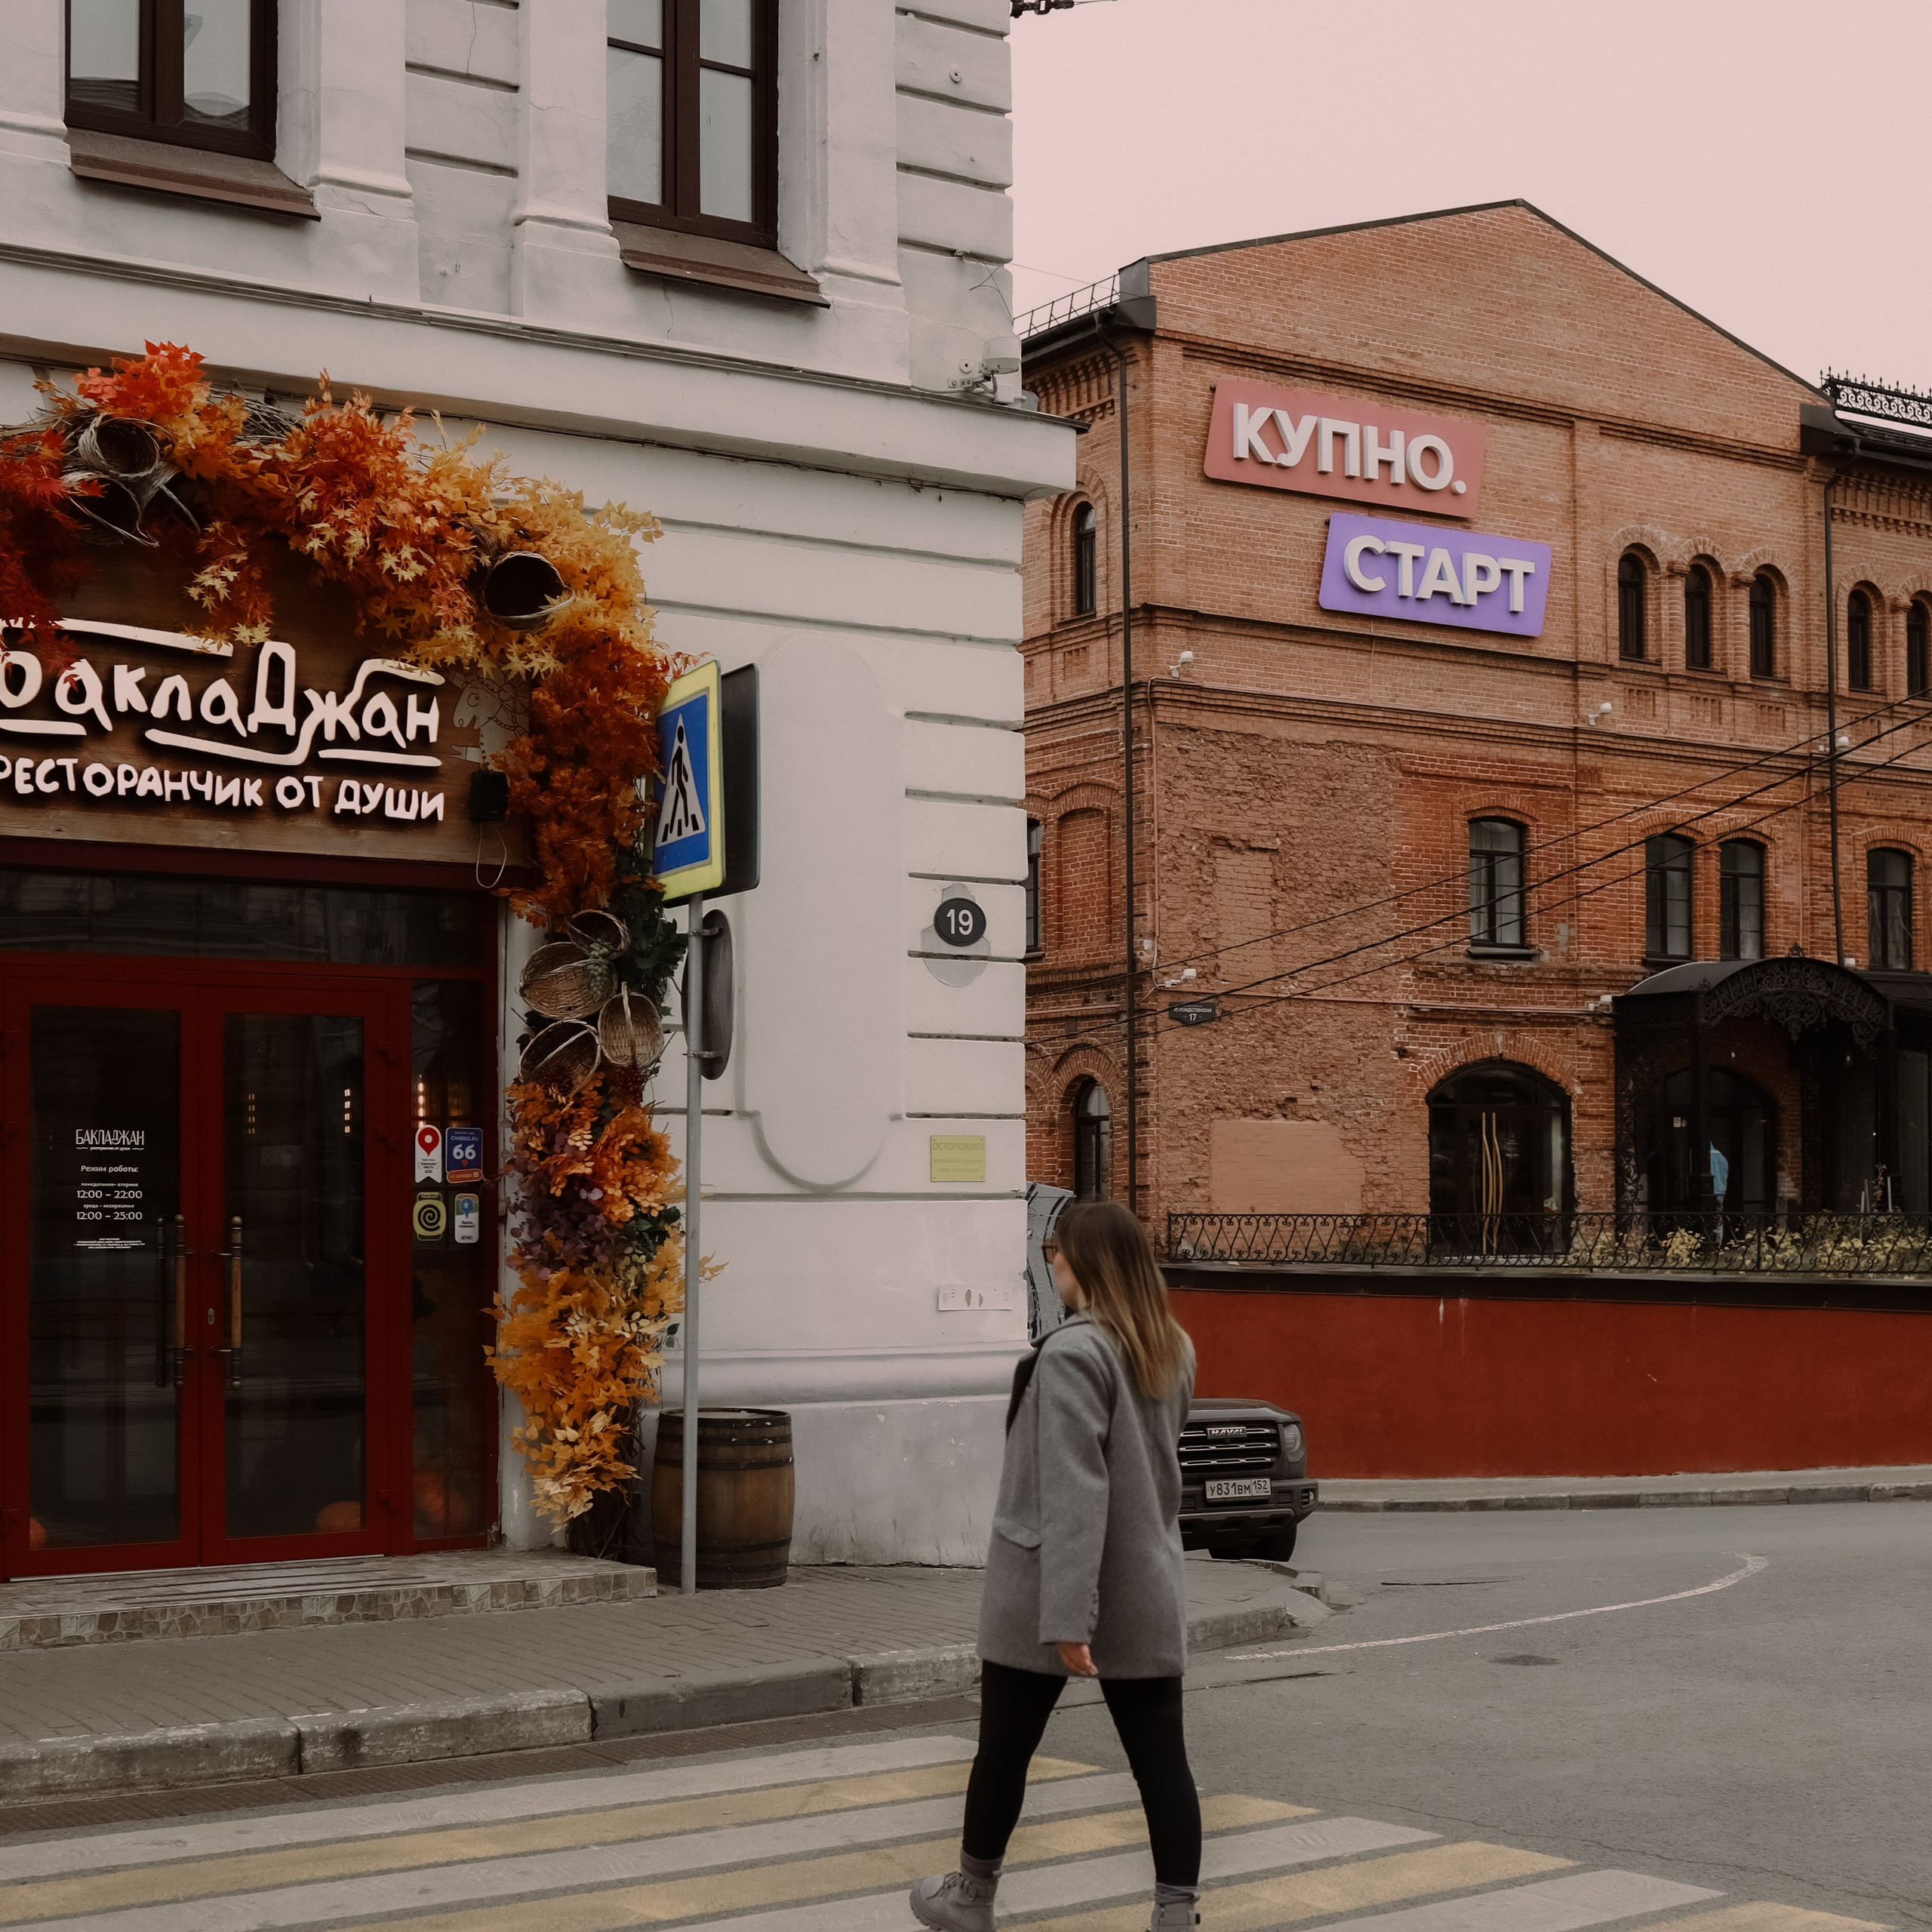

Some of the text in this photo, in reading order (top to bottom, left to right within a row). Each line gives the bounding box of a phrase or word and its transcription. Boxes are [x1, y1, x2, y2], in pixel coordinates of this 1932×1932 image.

[1232, 402, 1467, 495] КУПНО.
[1343, 534, 1536, 613] СТАРТ
[275, 776, 325, 809] ОТ
[334, 780, 445, 822] ДУШИ
[946, 909, 974, 936] 19
[1189, 1013, 1197, 1021] 17
[75, 1129, 145, 1146] БАКЛАДЖАН
[932, 1142, 985, 1151] ОСТОРОЖНО!
[76, 1190, 103, 1198] 12:00
[113, 1190, 143, 1198] 22:00
[76, 1211, 103, 1220] 12:00
